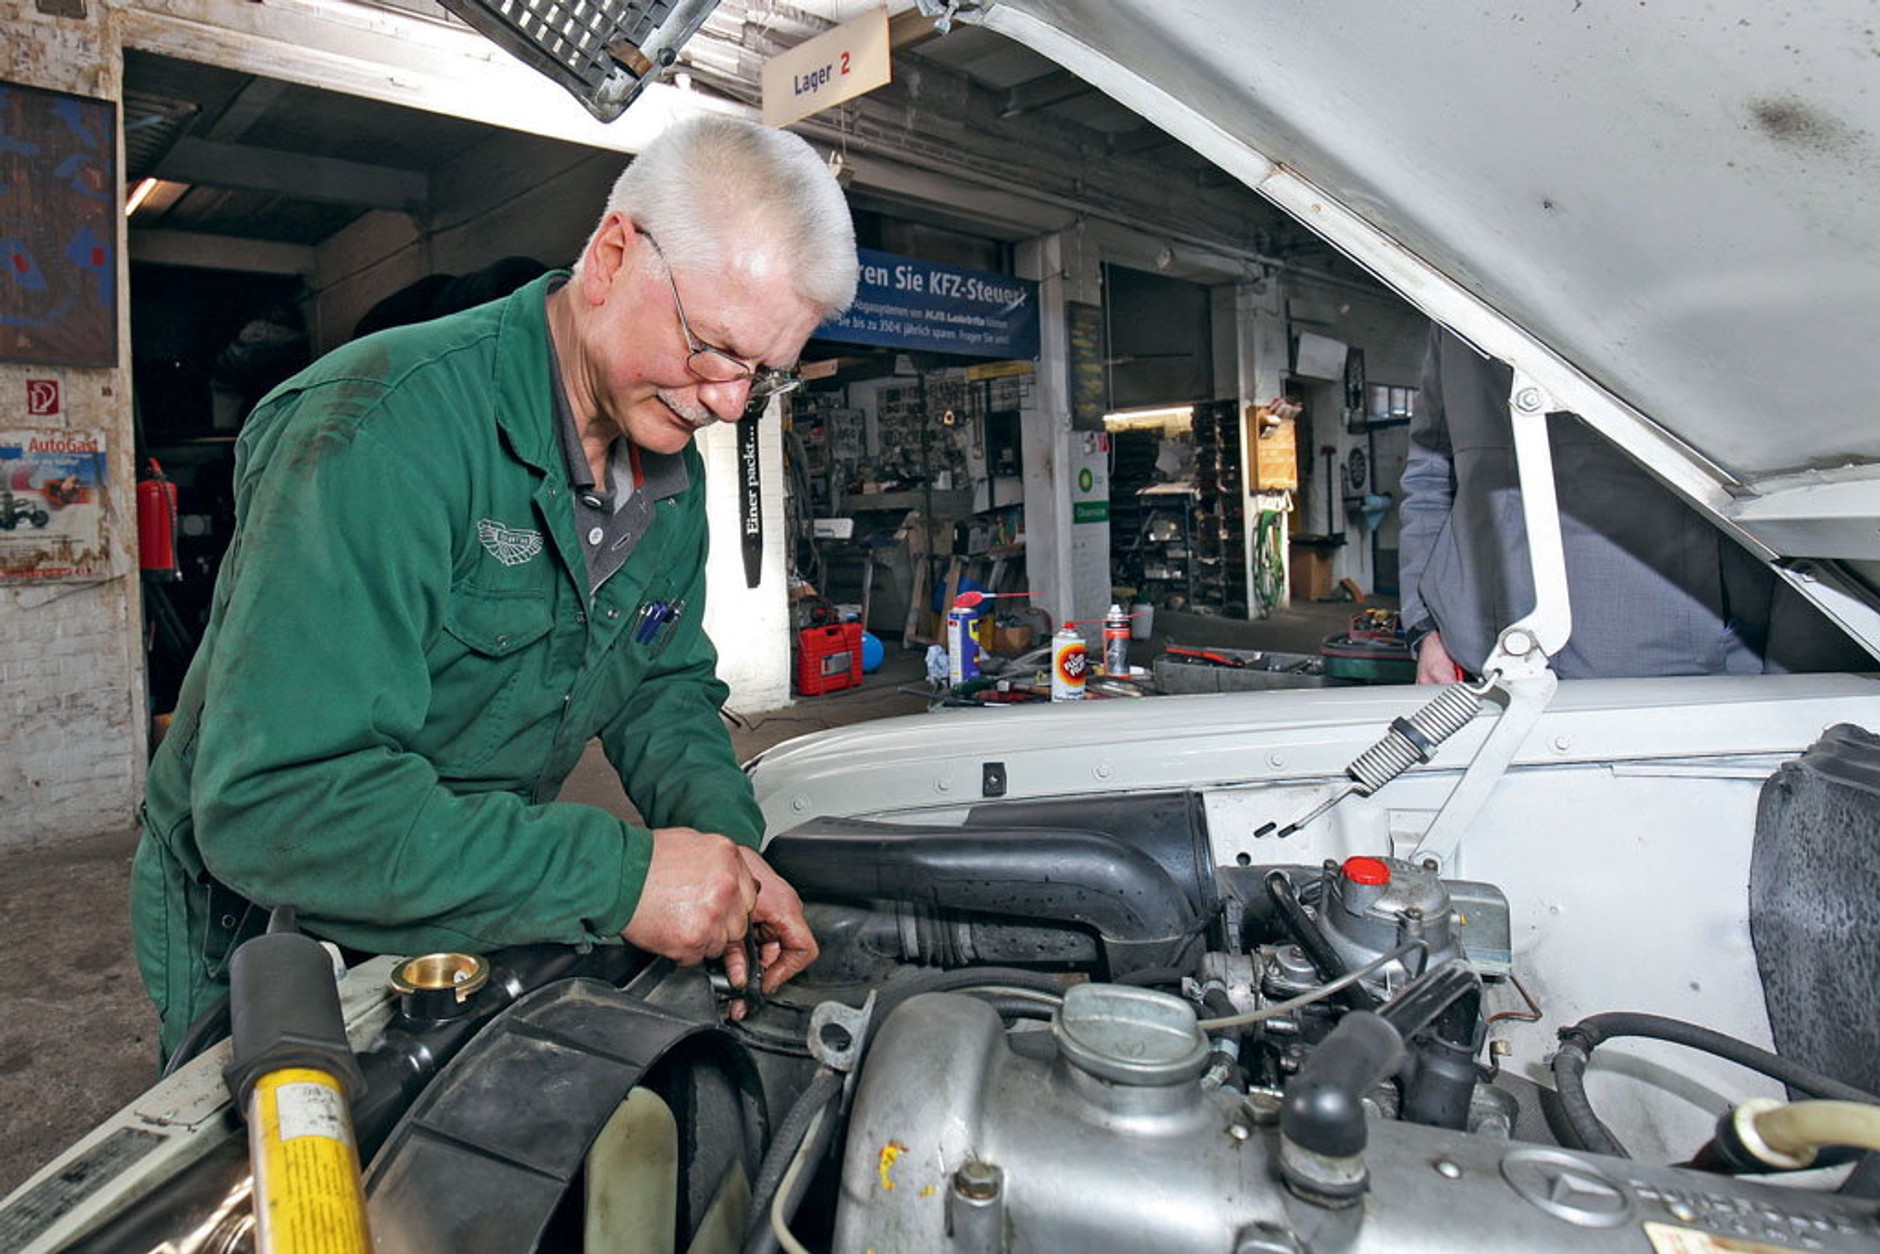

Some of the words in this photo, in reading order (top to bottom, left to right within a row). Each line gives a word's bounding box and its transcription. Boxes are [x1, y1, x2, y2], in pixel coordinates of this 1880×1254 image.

[795, 64, 832, 95] Lager
[841, 51, 850, 75] 2
[895, 265, 923, 292] Sie
[746, 491, 760, 536] Einer
